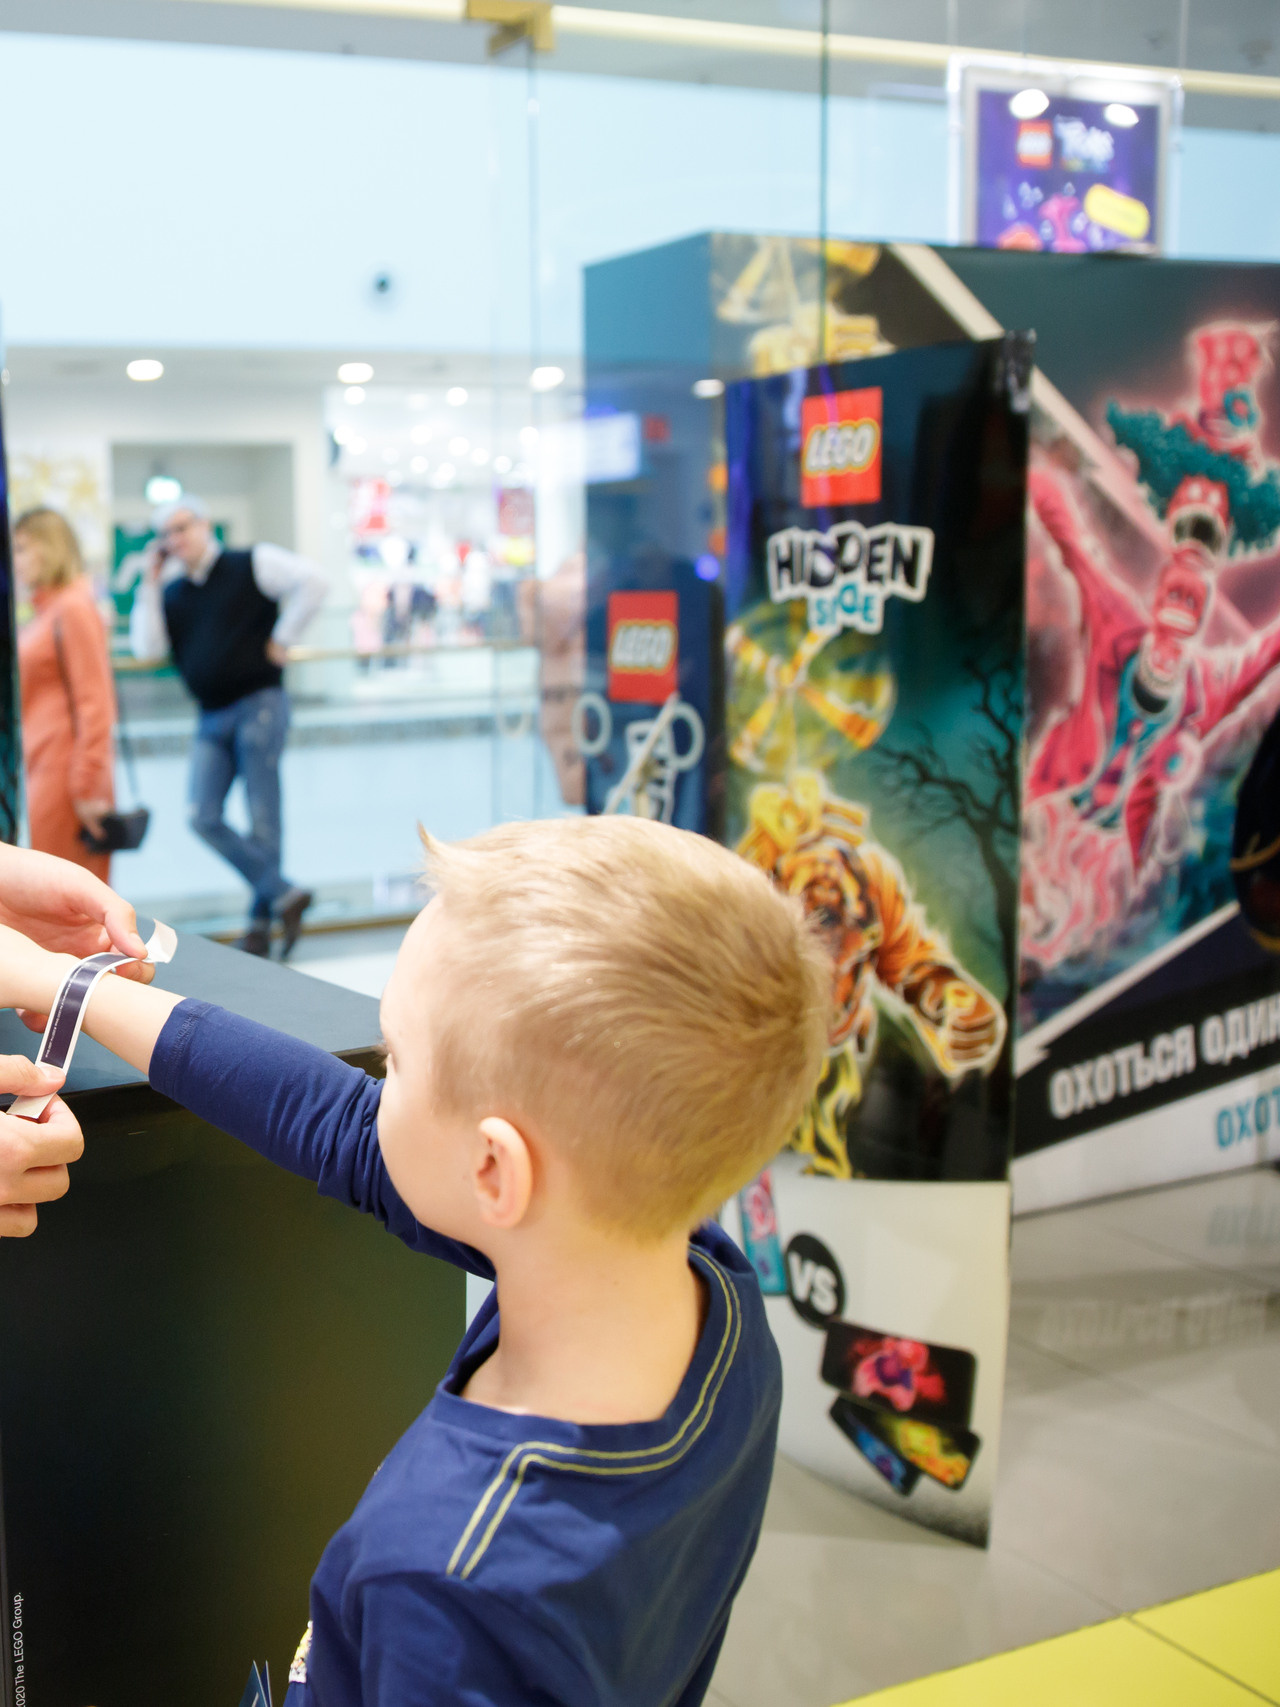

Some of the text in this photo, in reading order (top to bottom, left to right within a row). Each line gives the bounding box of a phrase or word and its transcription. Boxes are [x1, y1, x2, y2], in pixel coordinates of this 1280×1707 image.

[806, 423, 876, 473] LEGO
[773, 528, 924, 592] HIDDEN
[814, 582, 877, 628] SIDE
[1048, 1023, 1198, 1120] ОХОТЬСЯ
[786, 1252, 838, 1317] VS
[12, 1592, 26, 1707] 020 The LEGO Group.
